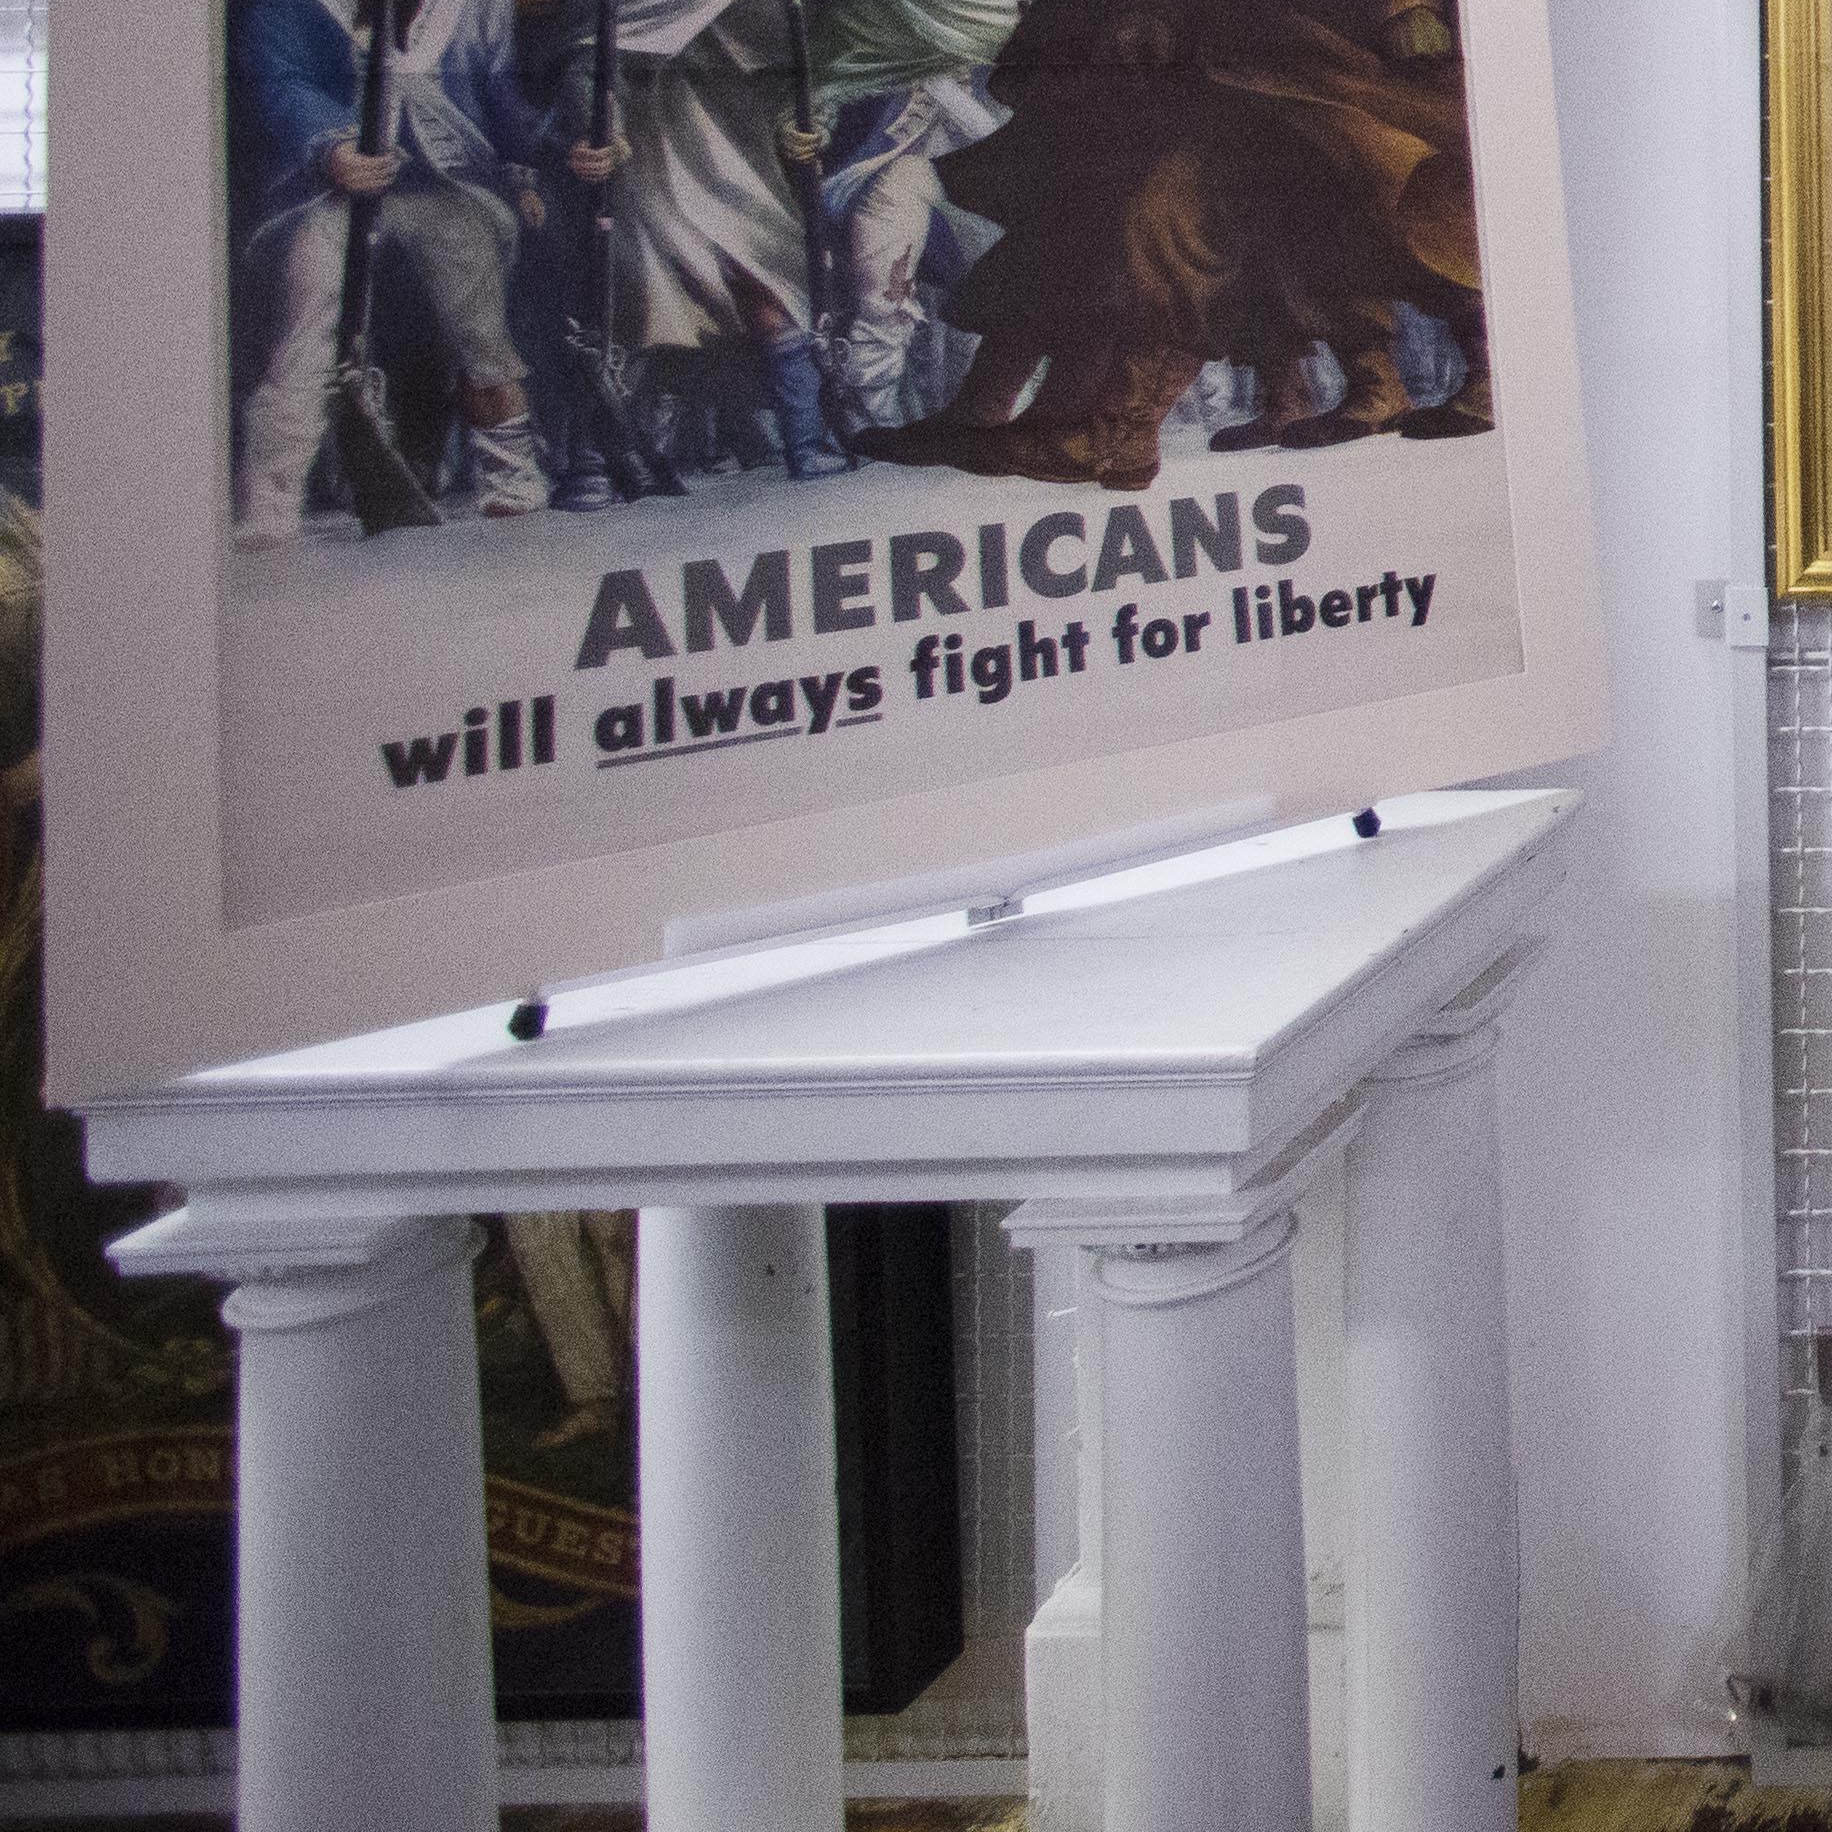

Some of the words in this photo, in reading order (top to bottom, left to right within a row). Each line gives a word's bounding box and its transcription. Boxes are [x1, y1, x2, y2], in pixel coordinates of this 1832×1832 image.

[574, 482, 1313, 671] AMERICANS
[380, 694, 557, 789] will
[594, 664, 884, 758] always
[909, 618, 1091, 704] fight
[1110, 603, 1212, 665] for
[1231, 570, 1438, 645] liberty
[99, 1446, 230, 1490] HON
